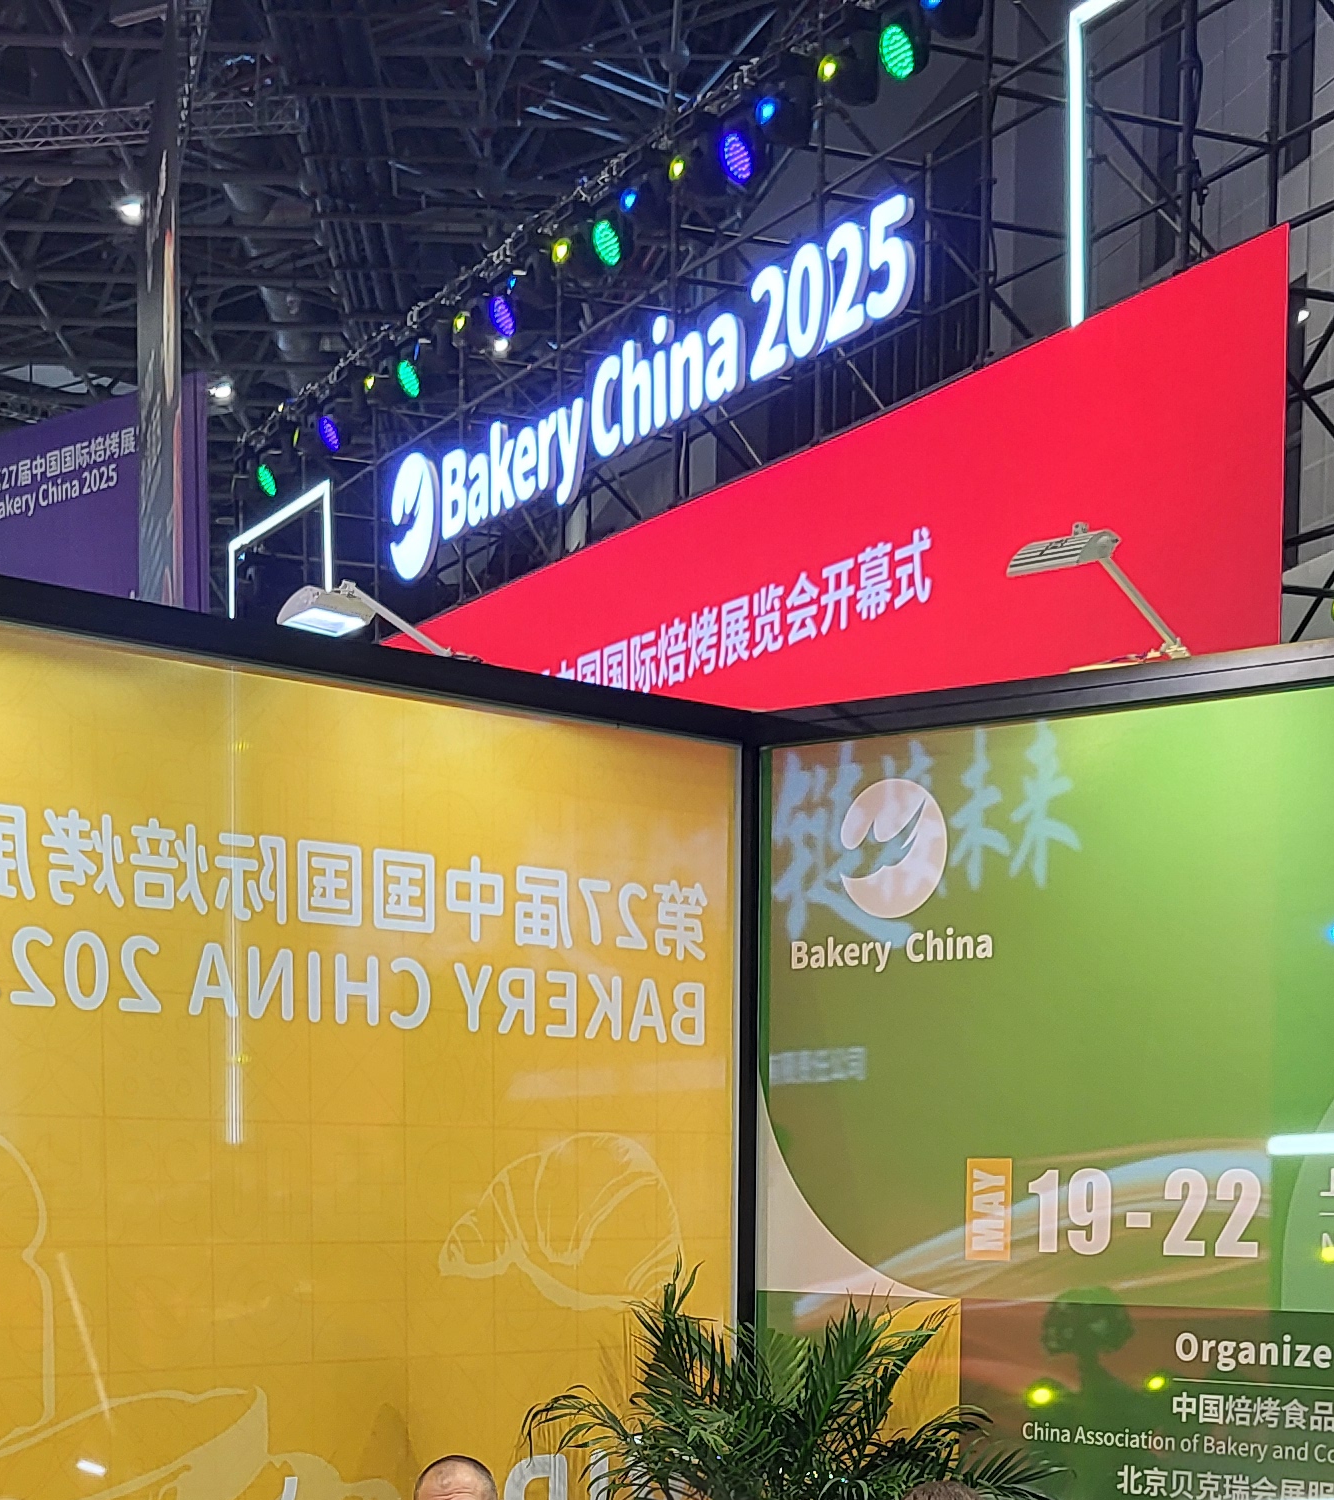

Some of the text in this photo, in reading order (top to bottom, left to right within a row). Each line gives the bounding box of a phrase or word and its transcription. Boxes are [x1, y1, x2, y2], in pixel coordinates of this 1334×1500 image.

[440, 192, 914, 541] Bakery China 2025
[38, 478, 80, 508] China
[82, 463, 117, 493] 2025
[542, 526, 933, 694] 国国际焙烤展览会开幕式
[790, 926, 994, 973] Bakery China
[971, 1168, 1006, 1251] MAY
[1022, 1421, 1071, 1444] China
[1074, 1425, 1176, 1453] Association
[1179, 1433, 1200, 1454] of
[1203, 1434, 1268, 1463] Bakery
[1272, 1441, 1309, 1462] and
